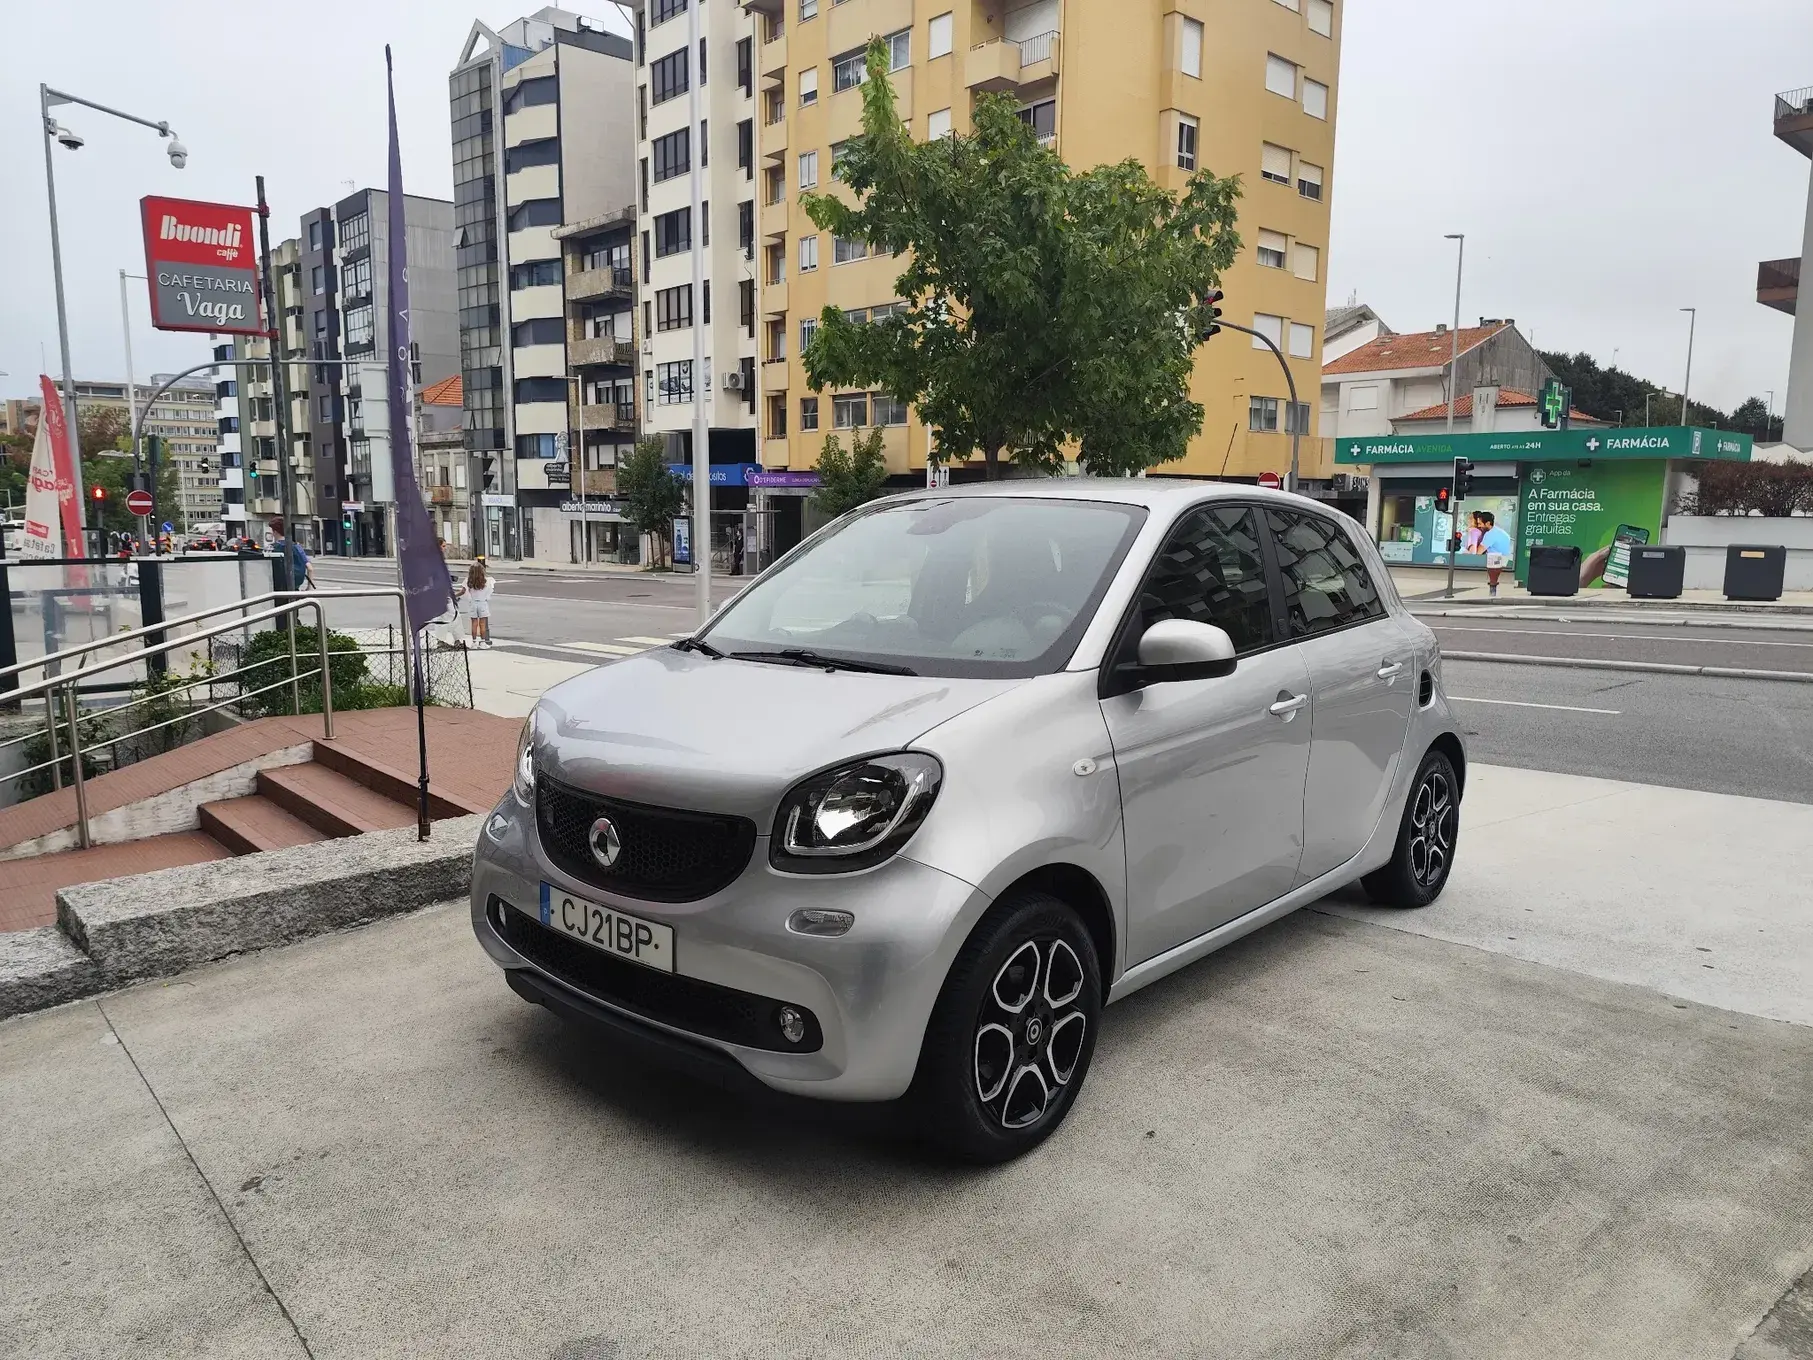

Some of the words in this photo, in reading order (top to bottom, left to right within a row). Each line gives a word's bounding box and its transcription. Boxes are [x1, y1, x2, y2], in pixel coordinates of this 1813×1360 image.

[160, 214, 242, 248] Buondi
[216, 248, 239, 261] caffè
[158, 272, 254, 294] CAFETARIA
[177, 291, 246, 326] Vaga
[1365, 443, 1414, 455] FARMÁCIA
[1416, 444, 1453, 454] AVENIDA
[1525, 441, 1542, 449] 24H
[1606, 435, 1670, 449] FARMÁCIA
[1528, 488, 1538, 499] A
[1540, 488, 1595, 499] Farmácia
[1527, 501, 1546, 511] em
[1548, 501, 1570, 511] sua
[1572, 501, 1604, 512] casa.
[1527, 511, 1577, 525] Entregas
[1525, 522, 1574, 536] gratuitas.
[562, 898, 653, 958] CJ21BP
